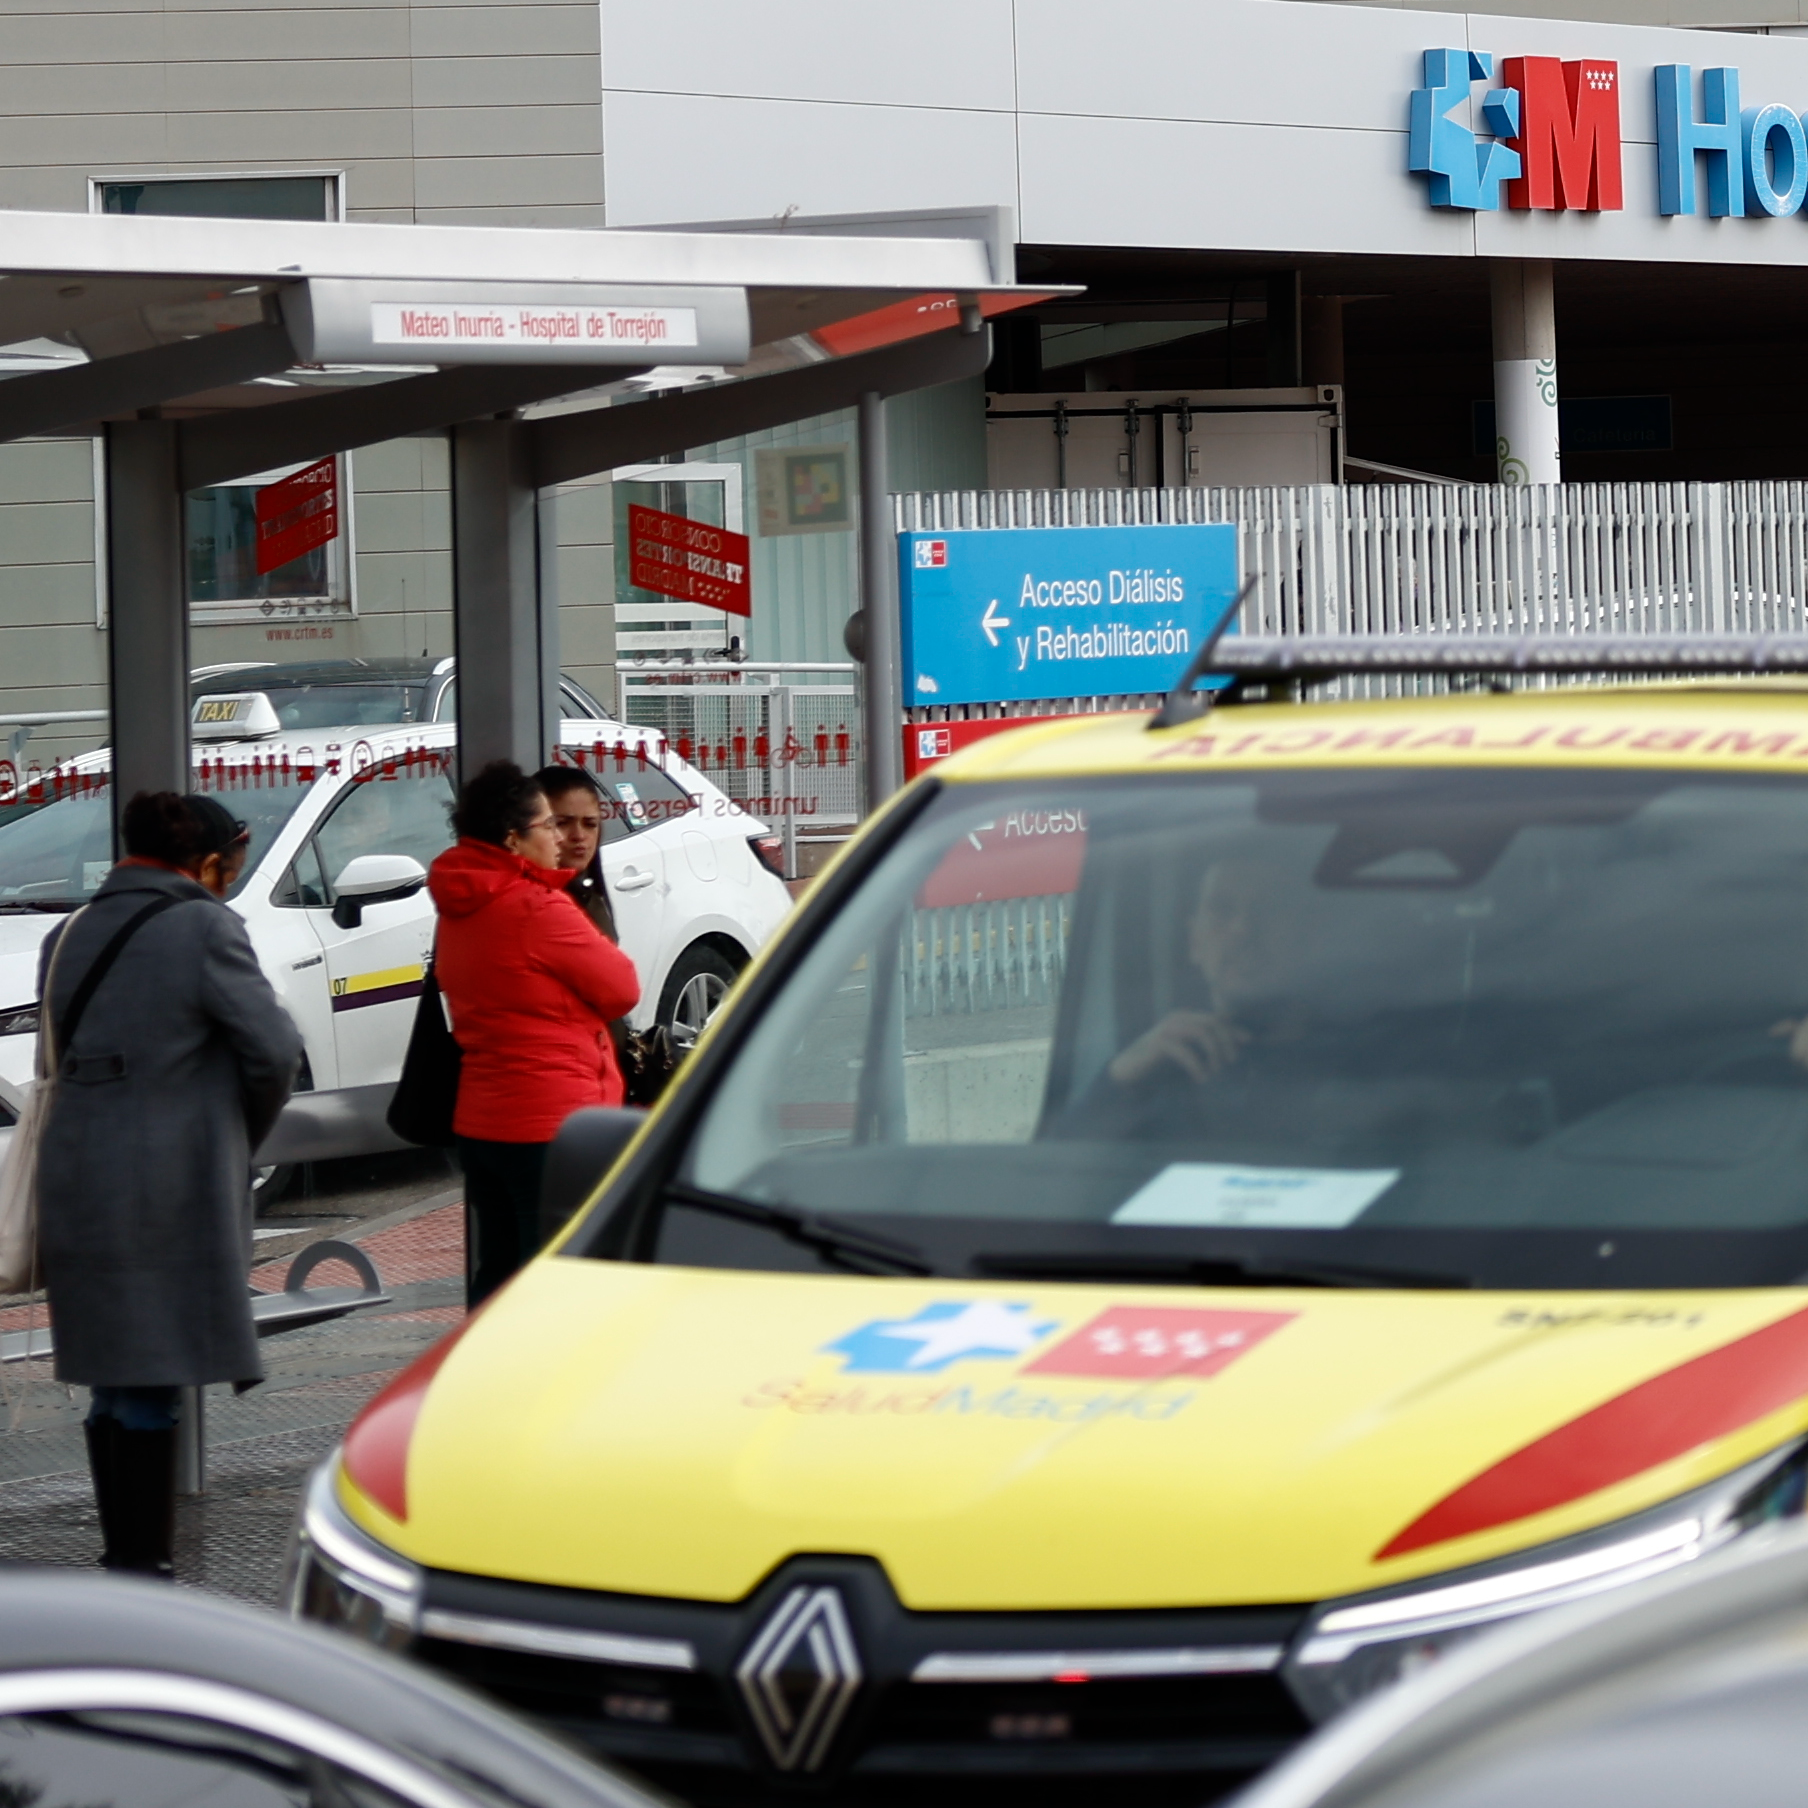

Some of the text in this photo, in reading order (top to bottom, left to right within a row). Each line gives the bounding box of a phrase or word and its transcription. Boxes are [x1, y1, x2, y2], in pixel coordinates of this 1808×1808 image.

[1503, 55, 1623, 212] M
[401, 310, 449, 339] Mateo
[520, 311, 581, 344] Hospital
[586, 312, 604, 339] de
[607, 311, 667, 345] Torrejón
[1020, 569, 1184, 608] Acceso Diálisis
[265, 626, 334, 642] www.crtm.es
[1017, 620, 1190, 671] y Rehabilitación
[198, 701, 240, 722] TAXI
[333, 977, 348, 995] 07
